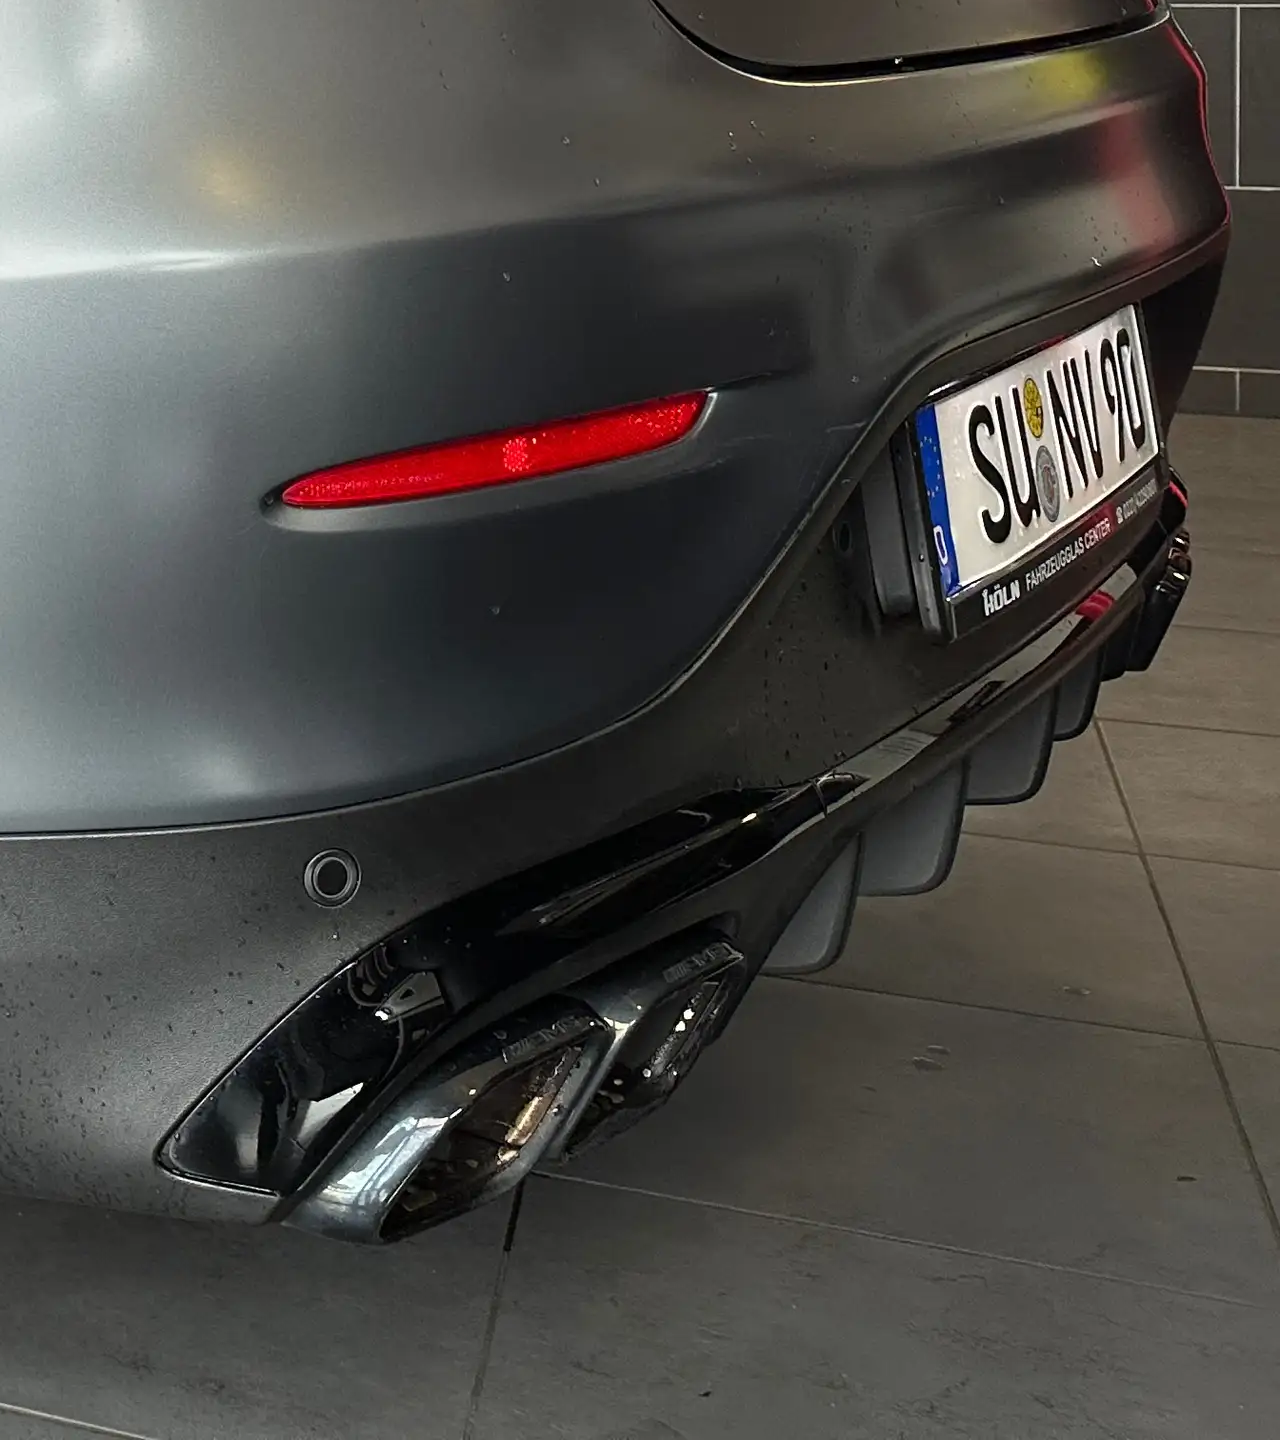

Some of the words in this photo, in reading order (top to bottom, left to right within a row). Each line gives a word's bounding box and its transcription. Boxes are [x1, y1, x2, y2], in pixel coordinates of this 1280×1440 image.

[969, 386, 1041, 544] SU
[1046, 350, 1104, 499] NV
[1099, 328, 1147, 463] 90
[933, 525, 948, 566] D
[1025, 537, 1085, 592] FAHRZEUGGLAS
[1084, 516, 1113, 550] CENTER
